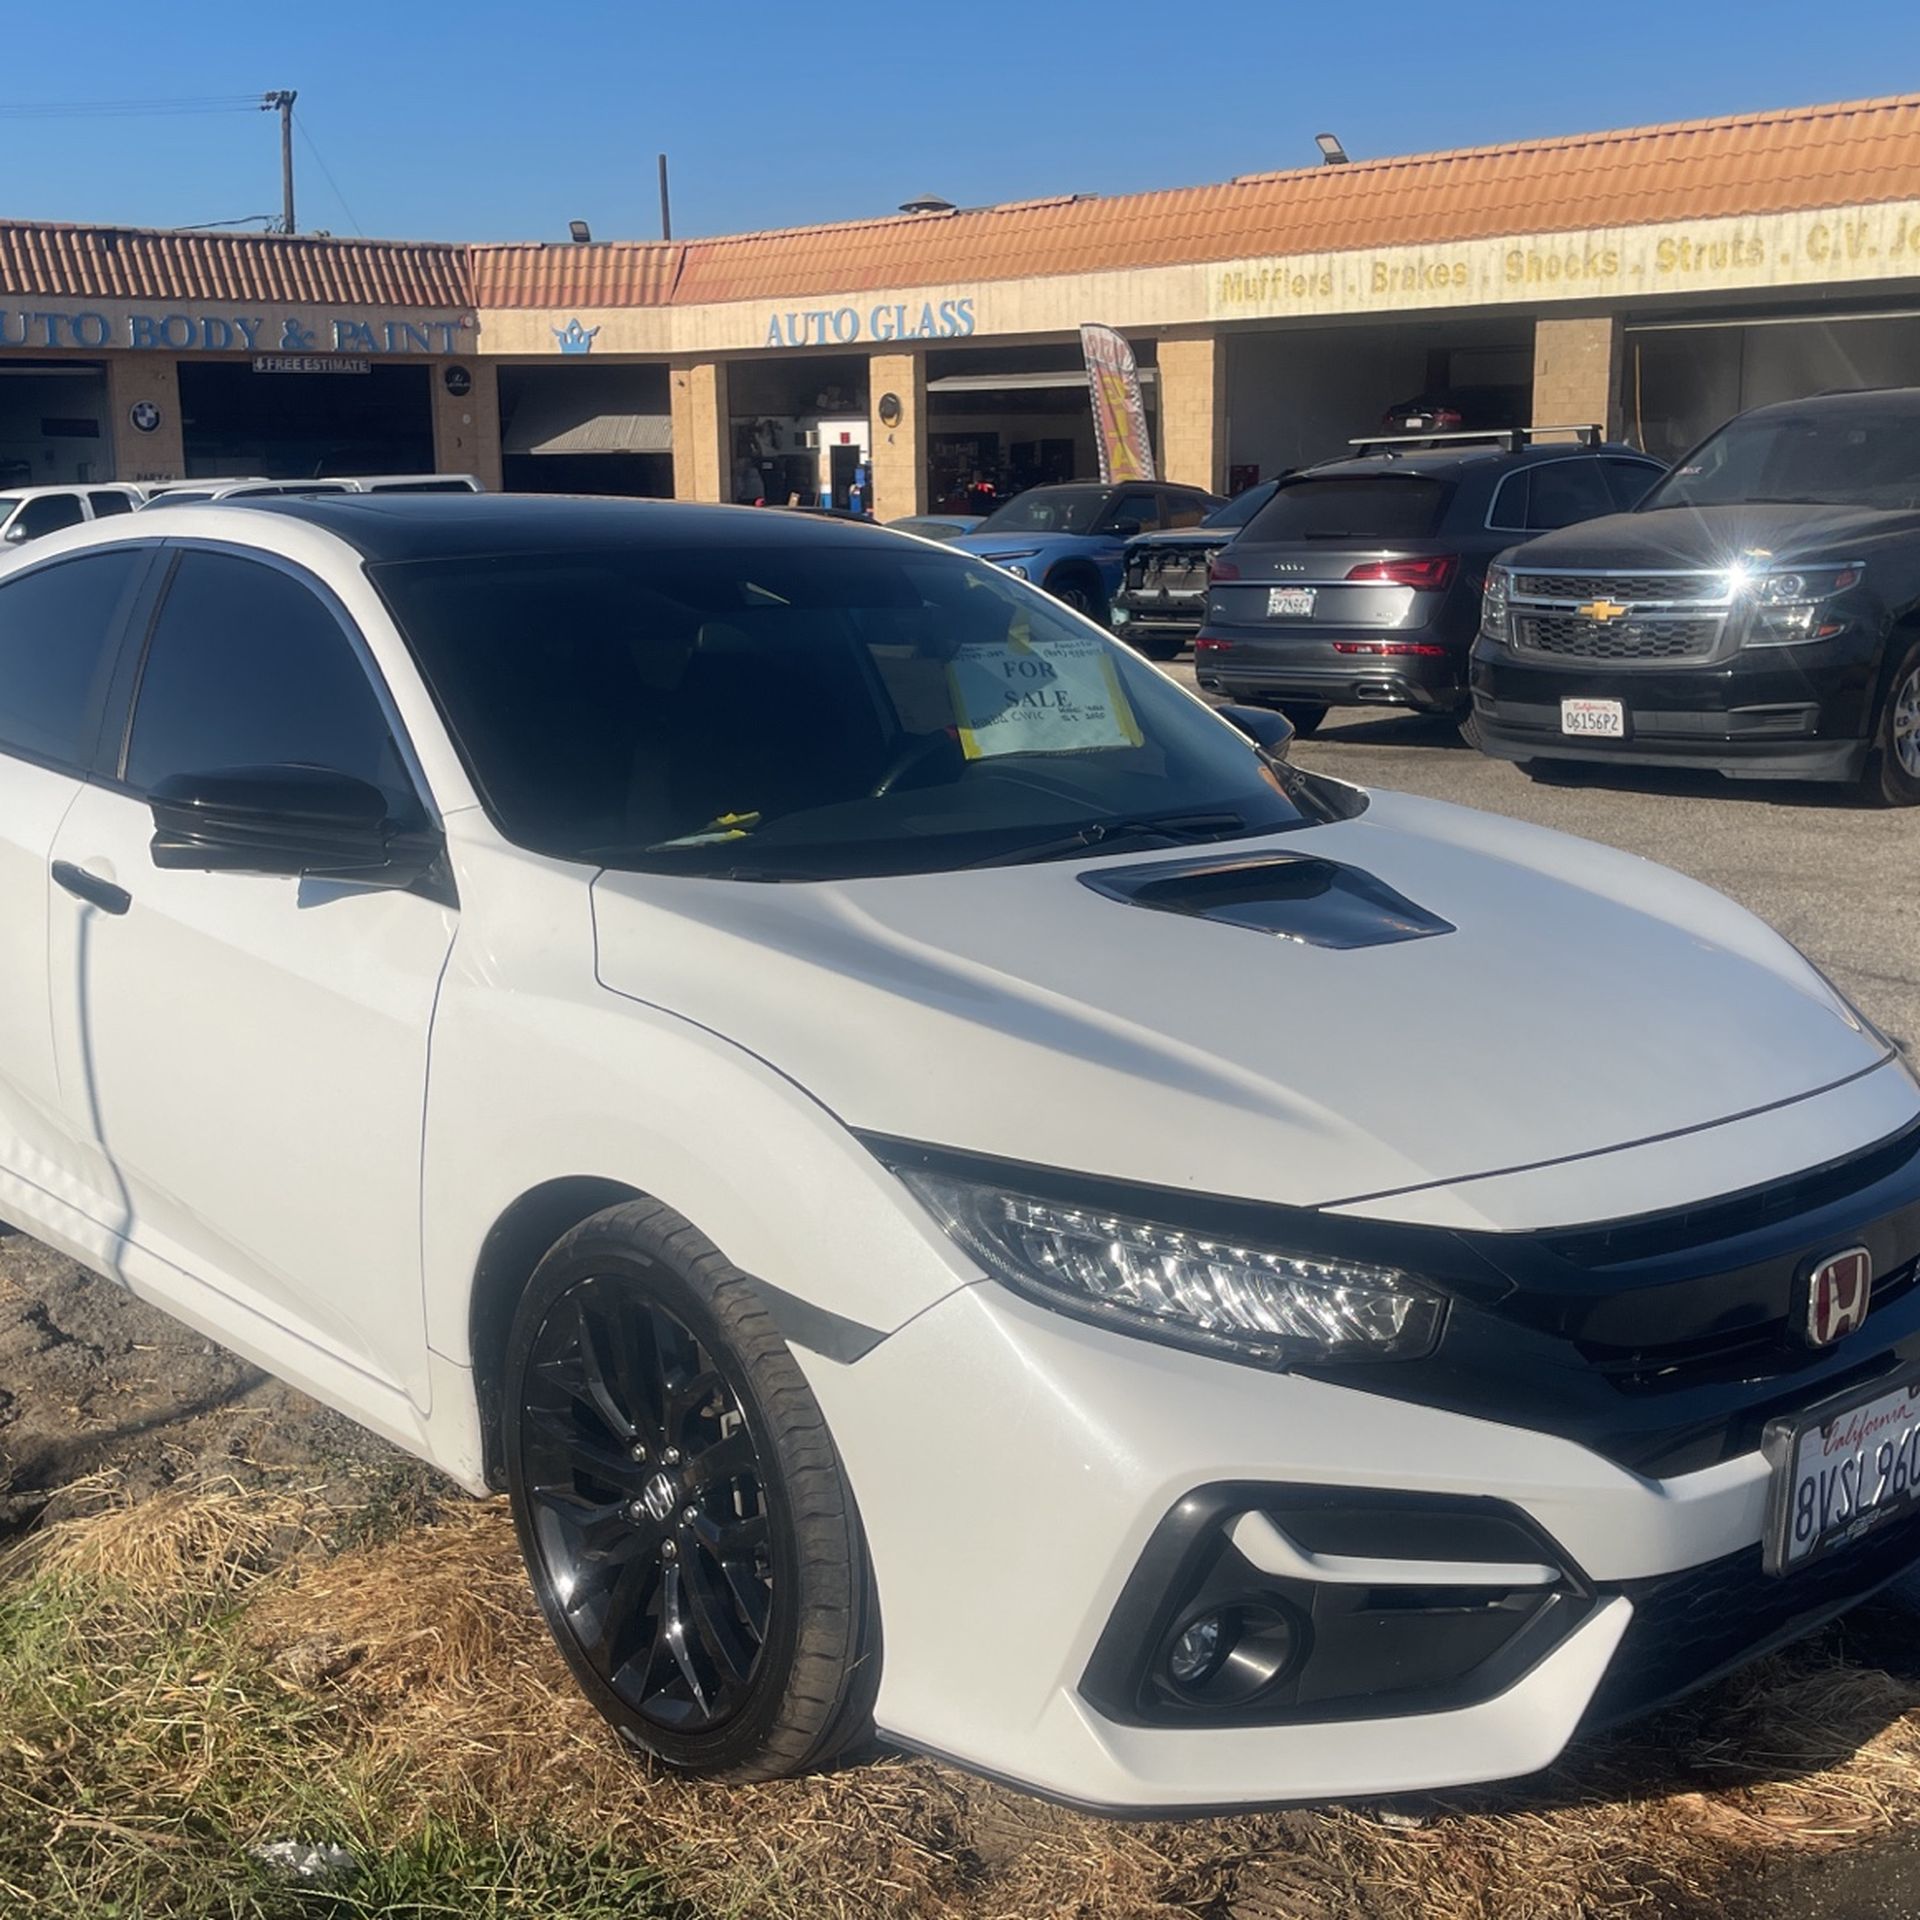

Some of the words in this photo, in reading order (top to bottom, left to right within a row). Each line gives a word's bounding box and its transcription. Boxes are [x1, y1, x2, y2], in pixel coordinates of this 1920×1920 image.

[1221, 267, 1333, 303] Mufflers
[1371, 257, 1468, 294] Brakes
[1505, 245, 1619, 283] Shocks
[1656, 234, 1764, 273] Struts
[766, 308, 860, 348] AUTO
[870, 299, 975, 342] GLASS
[127, 314, 264, 350] BODY
[279, 318, 316, 351] &
[330, 319, 462, 354] PAINT
[267, 358, 301, 371] FREE
[303, 359, 367, 373] ESTIMATE
[1003, 660, 1058, 679] FOR
[1004, 689, 1072, 708] SALE
[1011, 710, 1046, 722] CIVIC
[1566, 712, 1619, 731] 06156P2
[1823, 1404, 1915, 1457] California
